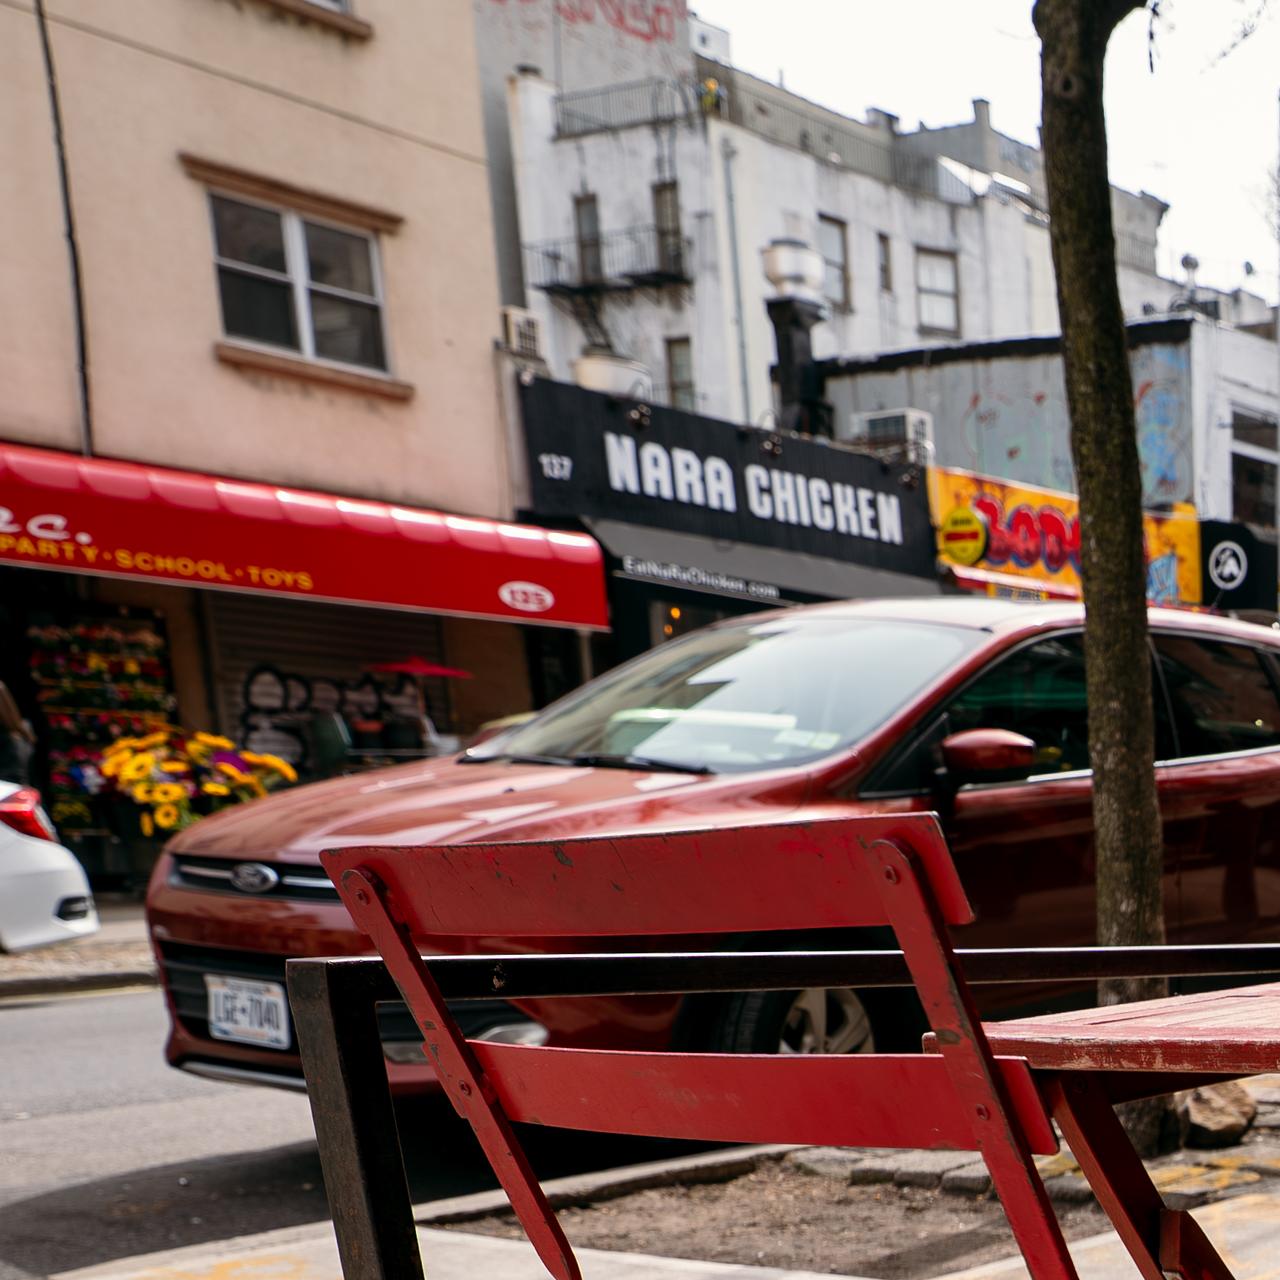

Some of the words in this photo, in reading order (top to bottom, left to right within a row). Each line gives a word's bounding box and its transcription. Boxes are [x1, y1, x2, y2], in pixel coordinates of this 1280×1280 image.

[538, 453, 573, 481] 137
[604, 431, 737, 513] NARA
[744, 463, 904, 546] CHICKEN
[114, 548, 233, 581] SCHOOL
[247, 565, 314, 590] TOYS
